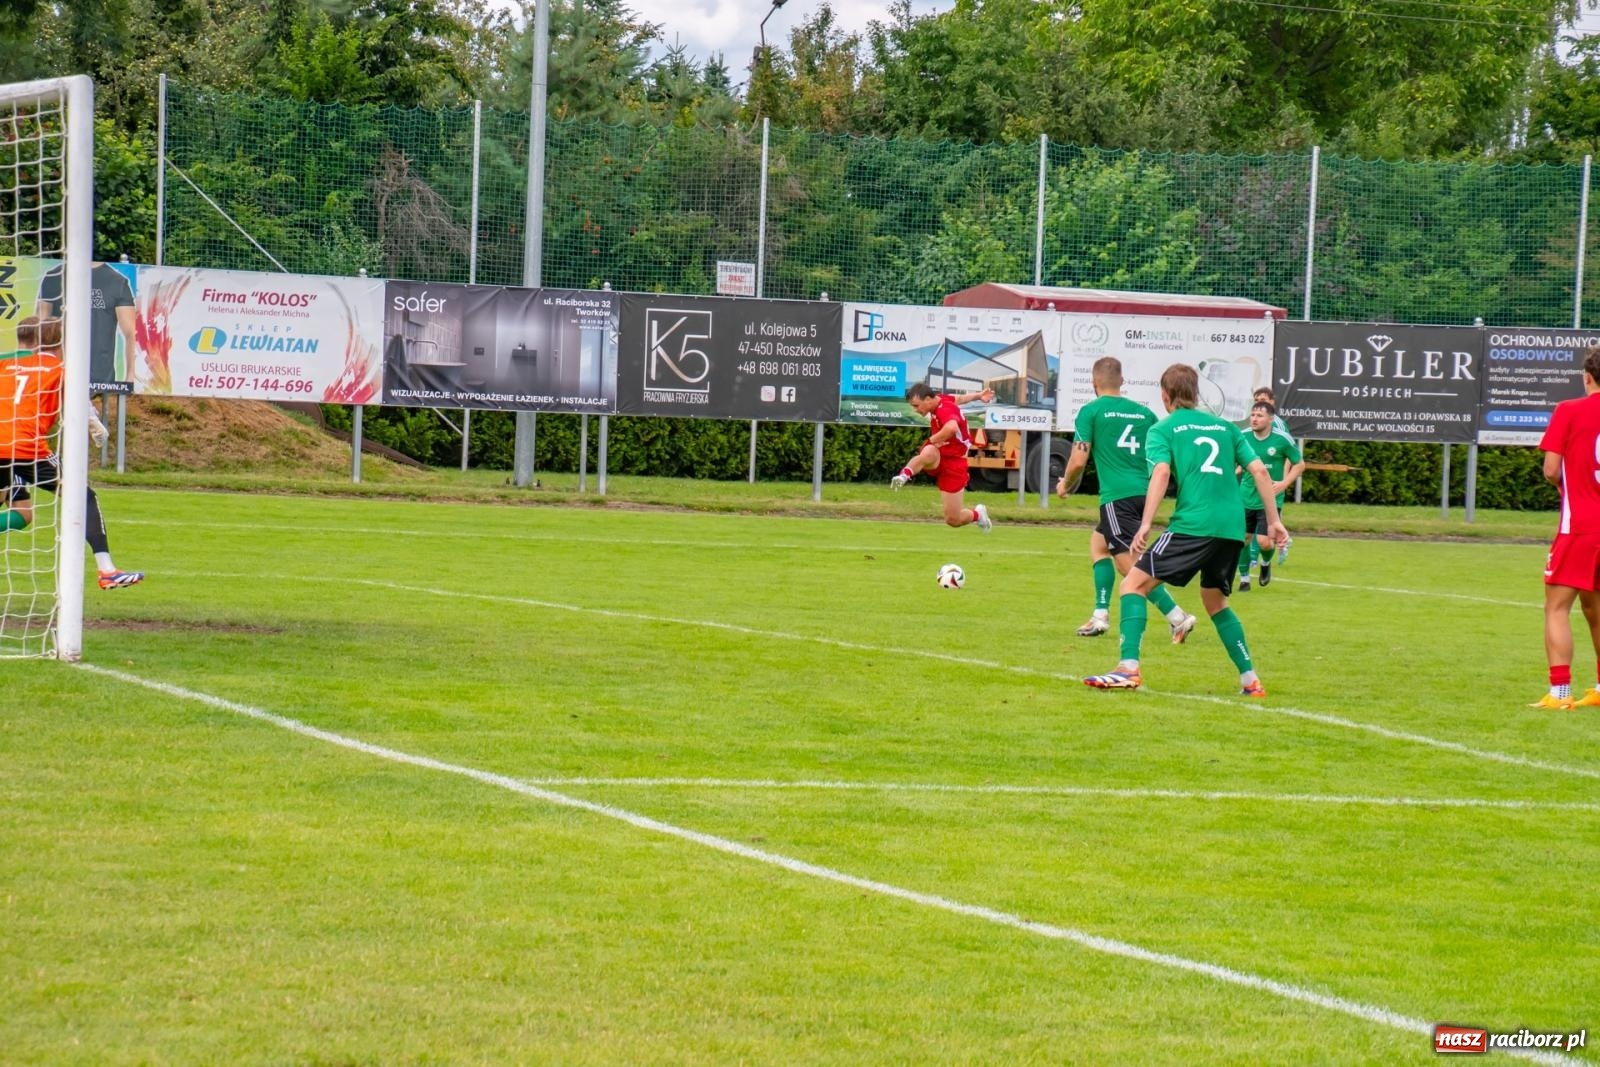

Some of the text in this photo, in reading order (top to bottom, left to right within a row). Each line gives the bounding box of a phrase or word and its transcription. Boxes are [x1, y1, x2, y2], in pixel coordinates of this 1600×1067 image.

[202, 289, 246, 304] Firma
[393, 291, 446, 313] safer
[555, 298, 599, 307] Raciborska
[601, 300, 611, 308] 32
[208, 305, 233, 314] Helena
[240, 307, 280, 316] Aleksander
[282, 310, 309, 318] Michna
[576, 308, 611, 317] Tworków
[235, 323, 292, 332] SKLEP
[744, 322, 817, 339] ul. Kolejowa 5
[875, 331, 907, 341] OKNA
[1125, 329, 1183, 342] GM-INSTAL
[1191, 333, 1265, 344] tel. 667 843 022
[1490, 334, 1600, 348] OCHRONA DANYC
[230, 335, 319, 353] LEWIATAN
[651, 316, 709, 383] K5
[738, 341, 822, 358] 47-450 Roszków
[1125, 341, 1183, 351] Marek Gawliczek
[1489, 349, 1574, 362] OSOBOWYCH
[201, 362, 301, 376] USŁUGI BRUKARSKIE
[737, 361, 821, 377] +48 698 061 803
[853, 365, 897, 373] NAJWIĘKSZA
[189, 375, 313, 392] tel: 507-144-696
[853, 374, 897, 382] EKSPOZYCJA
[1489, 375, 1538, 383] informatycznych
[14, 375, 29, 404] 7
[88, 383, 129, 392] AFTOWN.PL
[1343, 385, 1412, 398] POŚPIECH
[391, 389, 608, 405] WIZUALIZACJE WYPOSAŻENIE ŁAZIENEK INSTALACJE
[643, 391, 709, 404] PRACOWNIA FRYZJERSKA
[856, 410, 889, 418] Raciborska
[1017, 415, 1030, 423] 345
[1033, 416, 1047, 424] 032
[1279, 408, 1324, 418] RACIBÓRZ,
[1326, 410, 1340, 418] UL.
[1342, 410, 1401, 420] MICKIEWICZA
[1403, 412, 1412, 420] 13
[1419, 413, 1461, 421] OPAWSKA
[1317, 422, 1350, 432] RYBNIK,
[1353, 423, 1375, 431] PLAC
[1377, 423, 1424, 433] WOLNOŚCI
[1117, 424, 1140, 455] 4
[1193, 436, 1223, 475] 2
